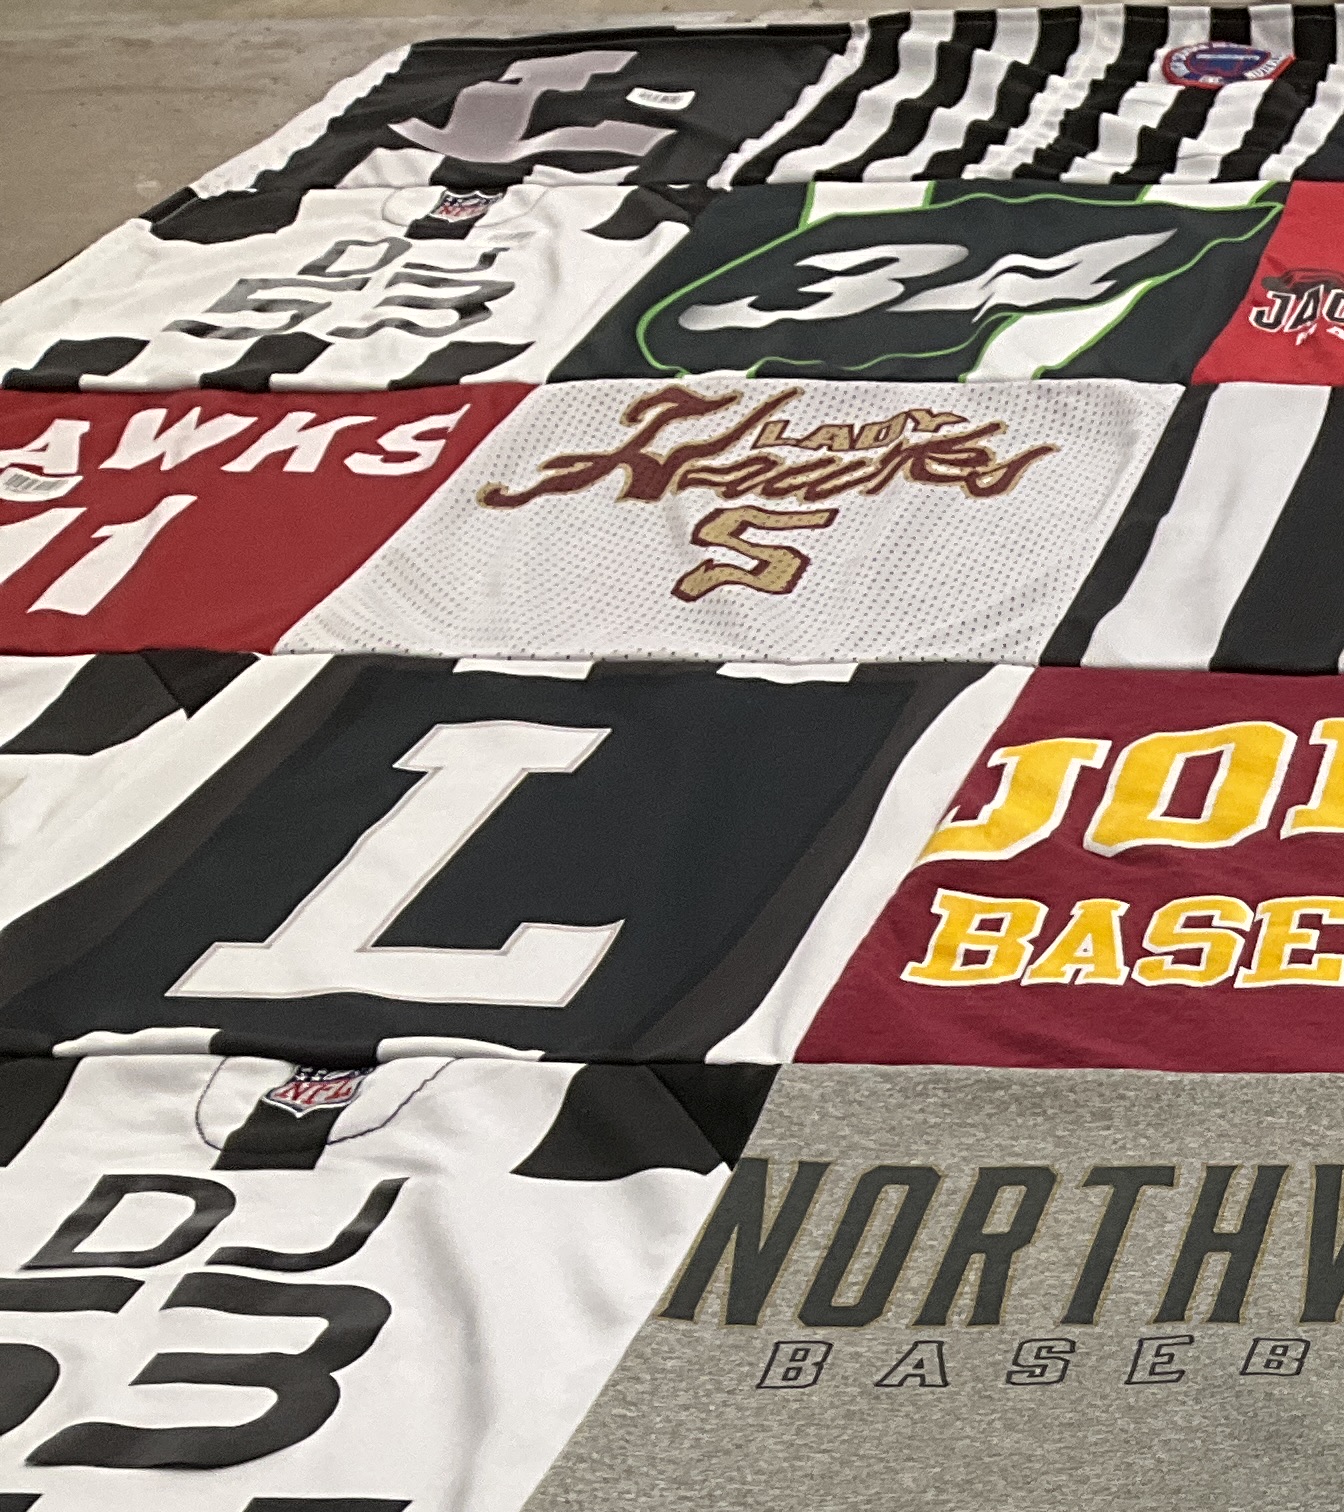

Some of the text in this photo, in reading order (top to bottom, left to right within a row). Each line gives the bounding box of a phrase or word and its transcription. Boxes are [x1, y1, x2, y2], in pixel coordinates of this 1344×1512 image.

[163, 274, 517, 340] 53
[678, 228, 1178, 331] 34
[751, 407, 968, 451] LADY
[672, 505, 840, 603] 5
[165, 719, 626, 1007] L
[273, 1079, 352, 1104] NFL
[19, 1174, 411, 1272] DJ
